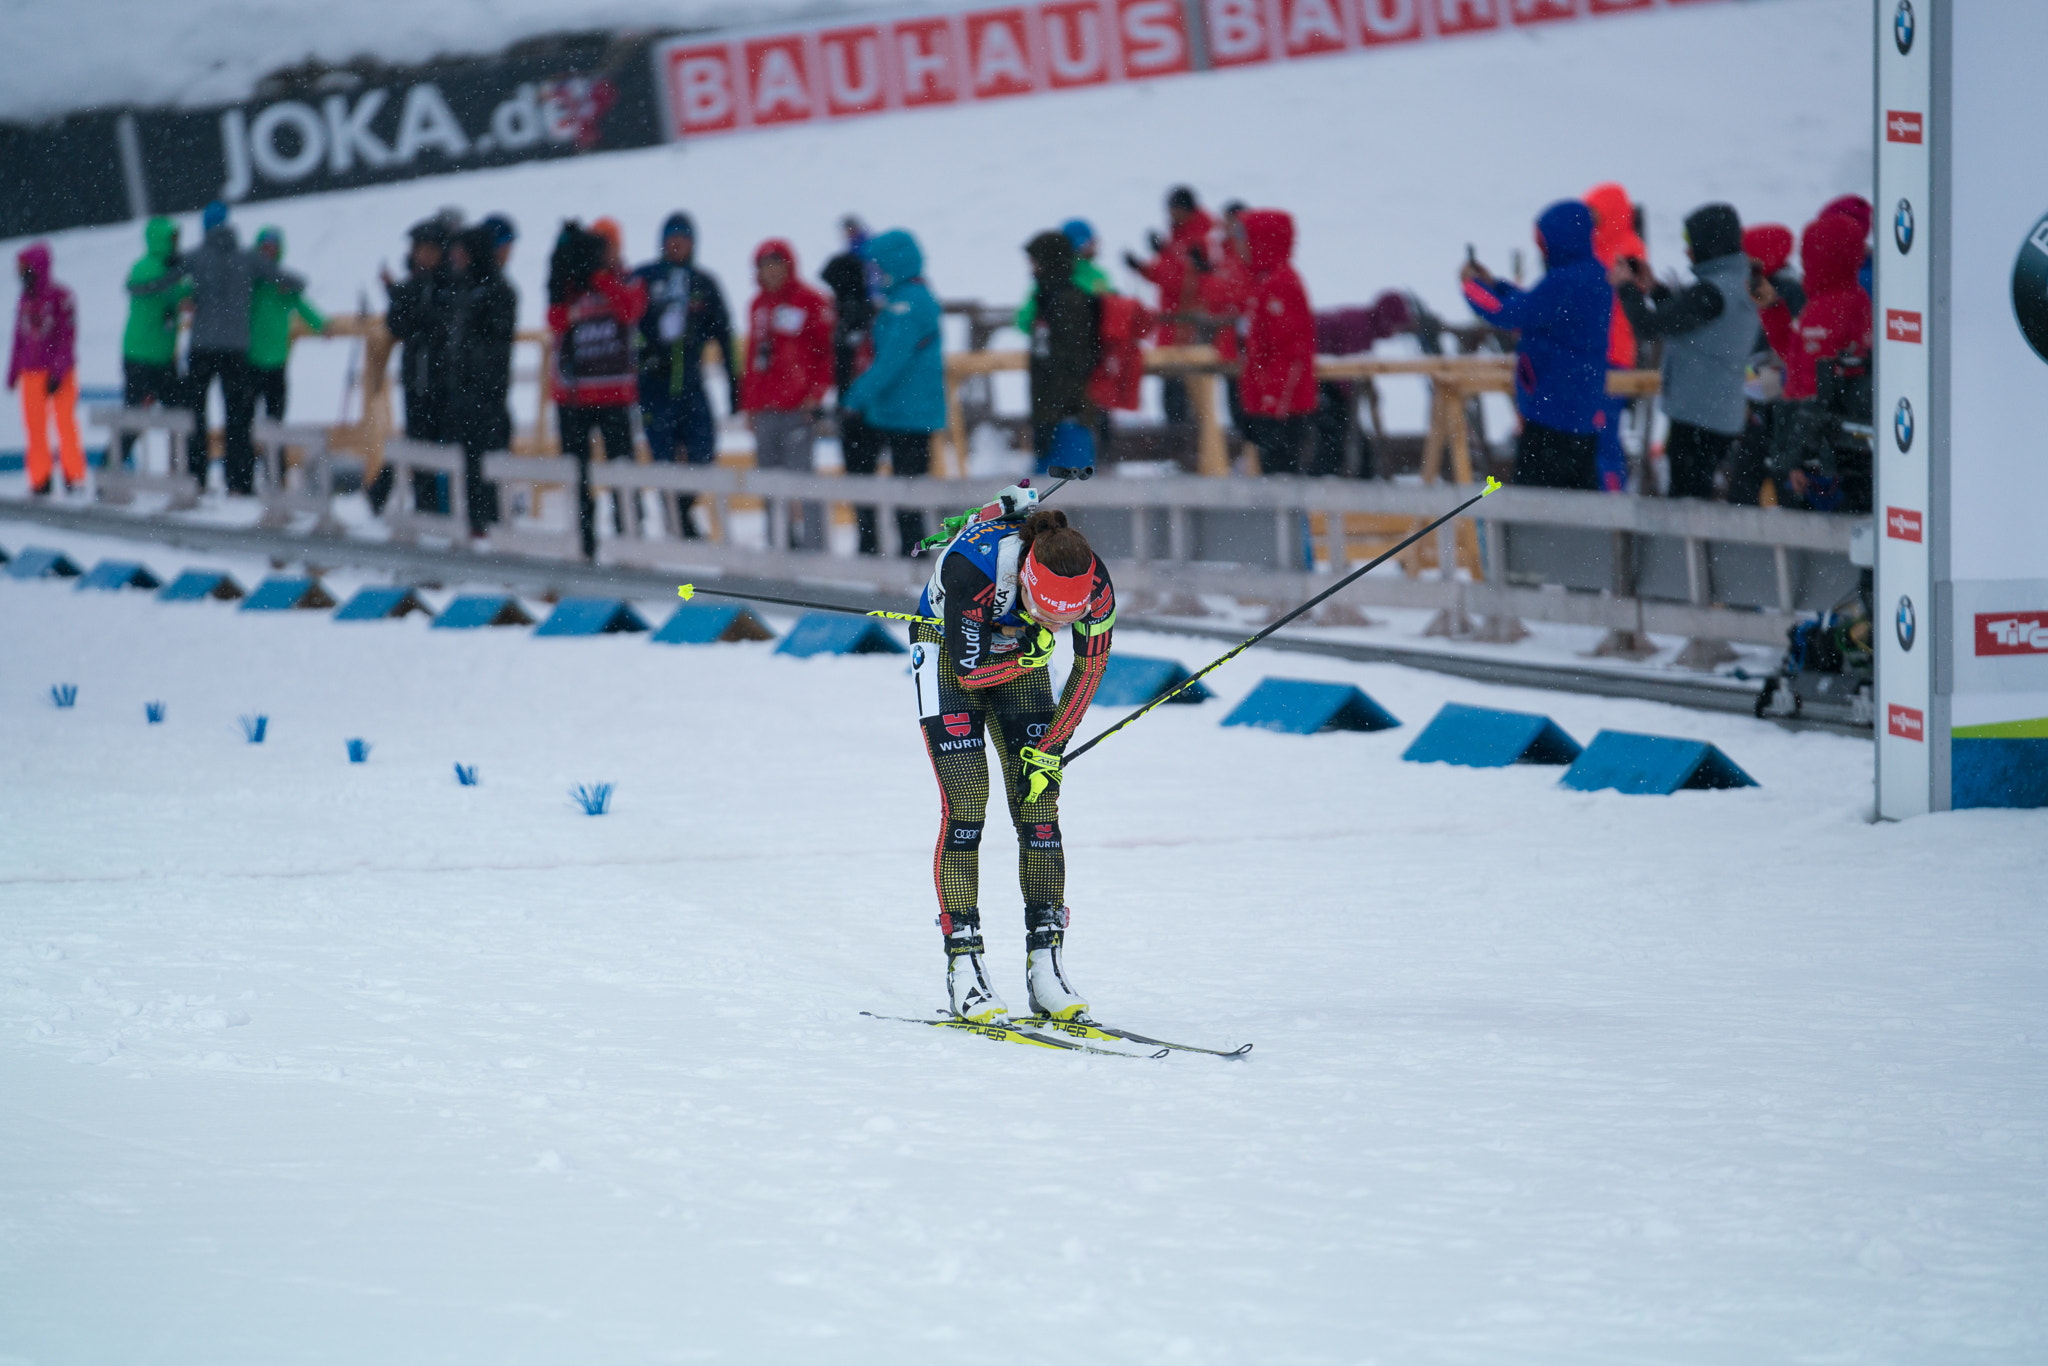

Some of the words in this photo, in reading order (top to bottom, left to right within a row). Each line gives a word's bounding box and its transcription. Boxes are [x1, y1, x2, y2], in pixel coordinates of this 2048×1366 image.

[676, 2, 1184, 124] BAUHAUS
[960, 626, 981, 669] Audi
[939, 738, 984, 752] WÜRTH
[1023, 1021, 1088, 1038] FISHER
